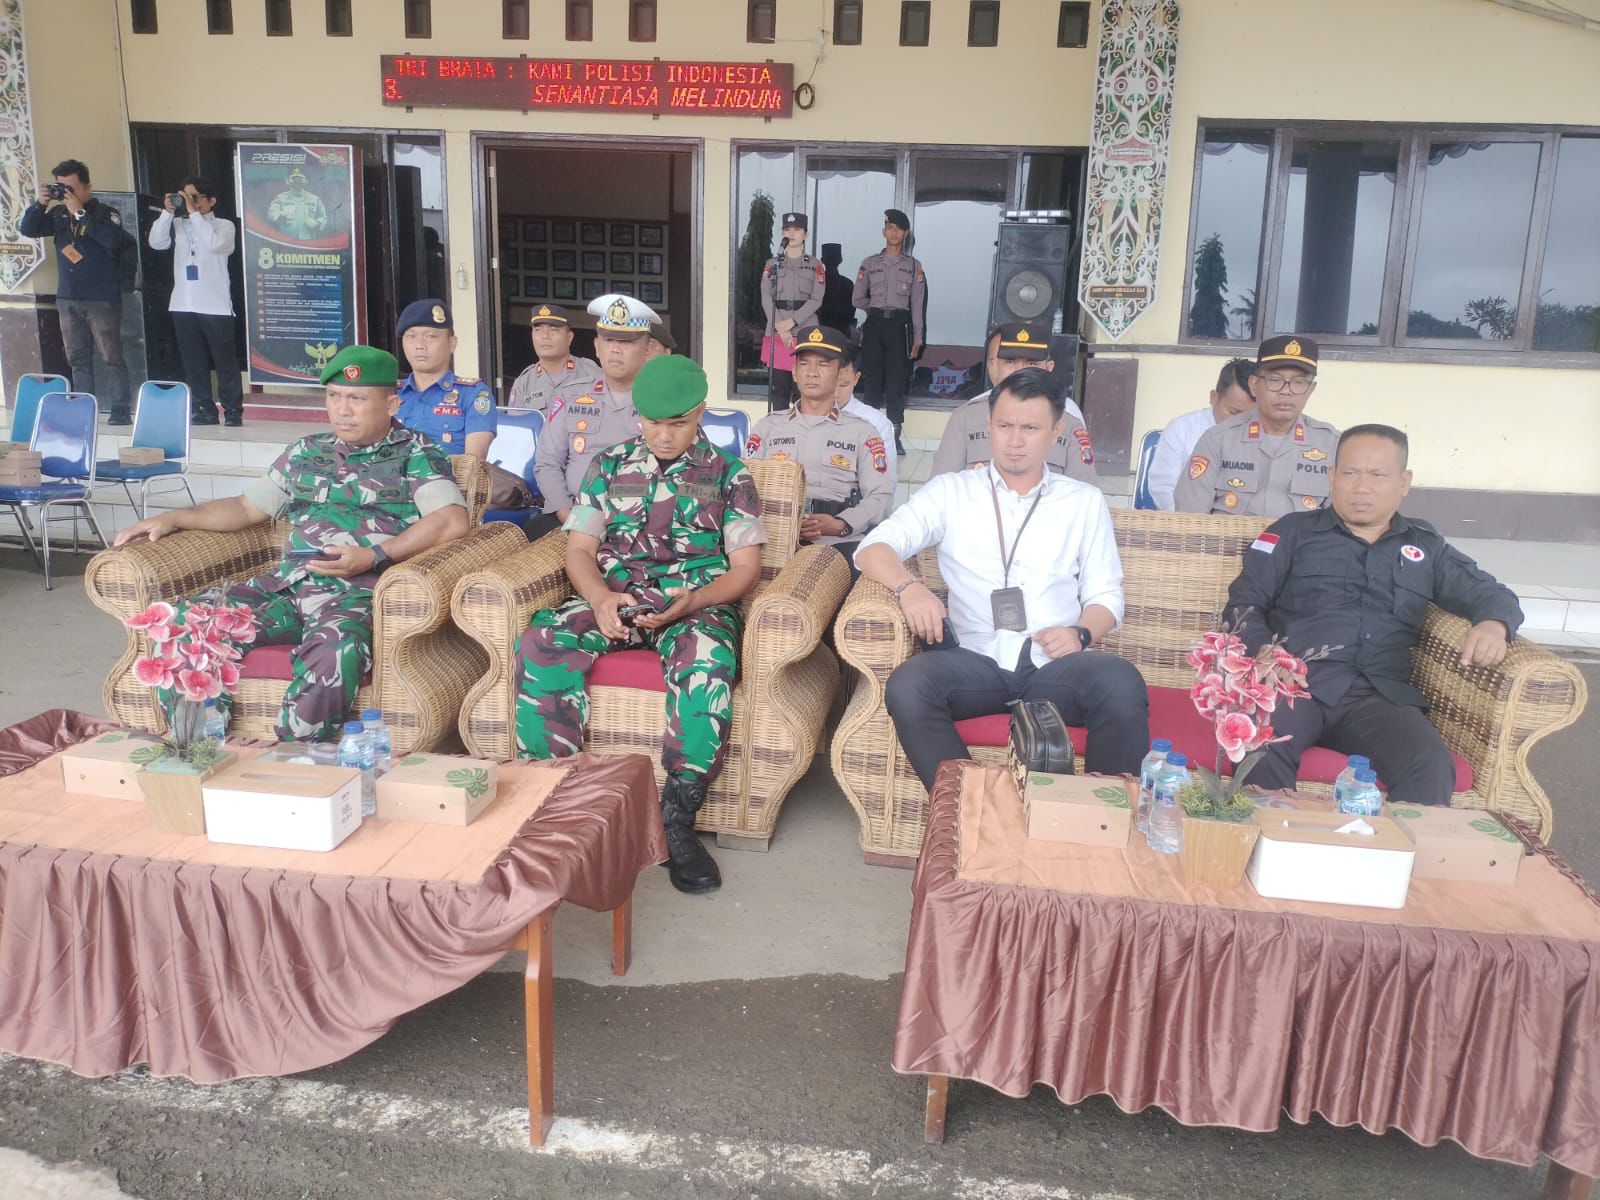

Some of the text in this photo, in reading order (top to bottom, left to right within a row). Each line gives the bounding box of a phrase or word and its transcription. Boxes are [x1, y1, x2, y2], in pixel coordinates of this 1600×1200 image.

[395, 59, 428, 78] TRI
[439, 60, 496, 79] BRATA
[528, 62, 573, 80] KAMI
[585, 64, 654, 82] POLISI
[667, 65, 772, 84] INDONESIA
[532, 84, 659, 107] SENANTIASA
[258, 247, 341, 270] 8 KOMITMEN
[433, 406, 461, 415] PMK
[567, 405, 601, 417] ANSAR
[826, 440, 856, 452] POLRI
[1221, 459, 1255, 471] MUADIB
[1296, 462, 1328, 474] POLR
